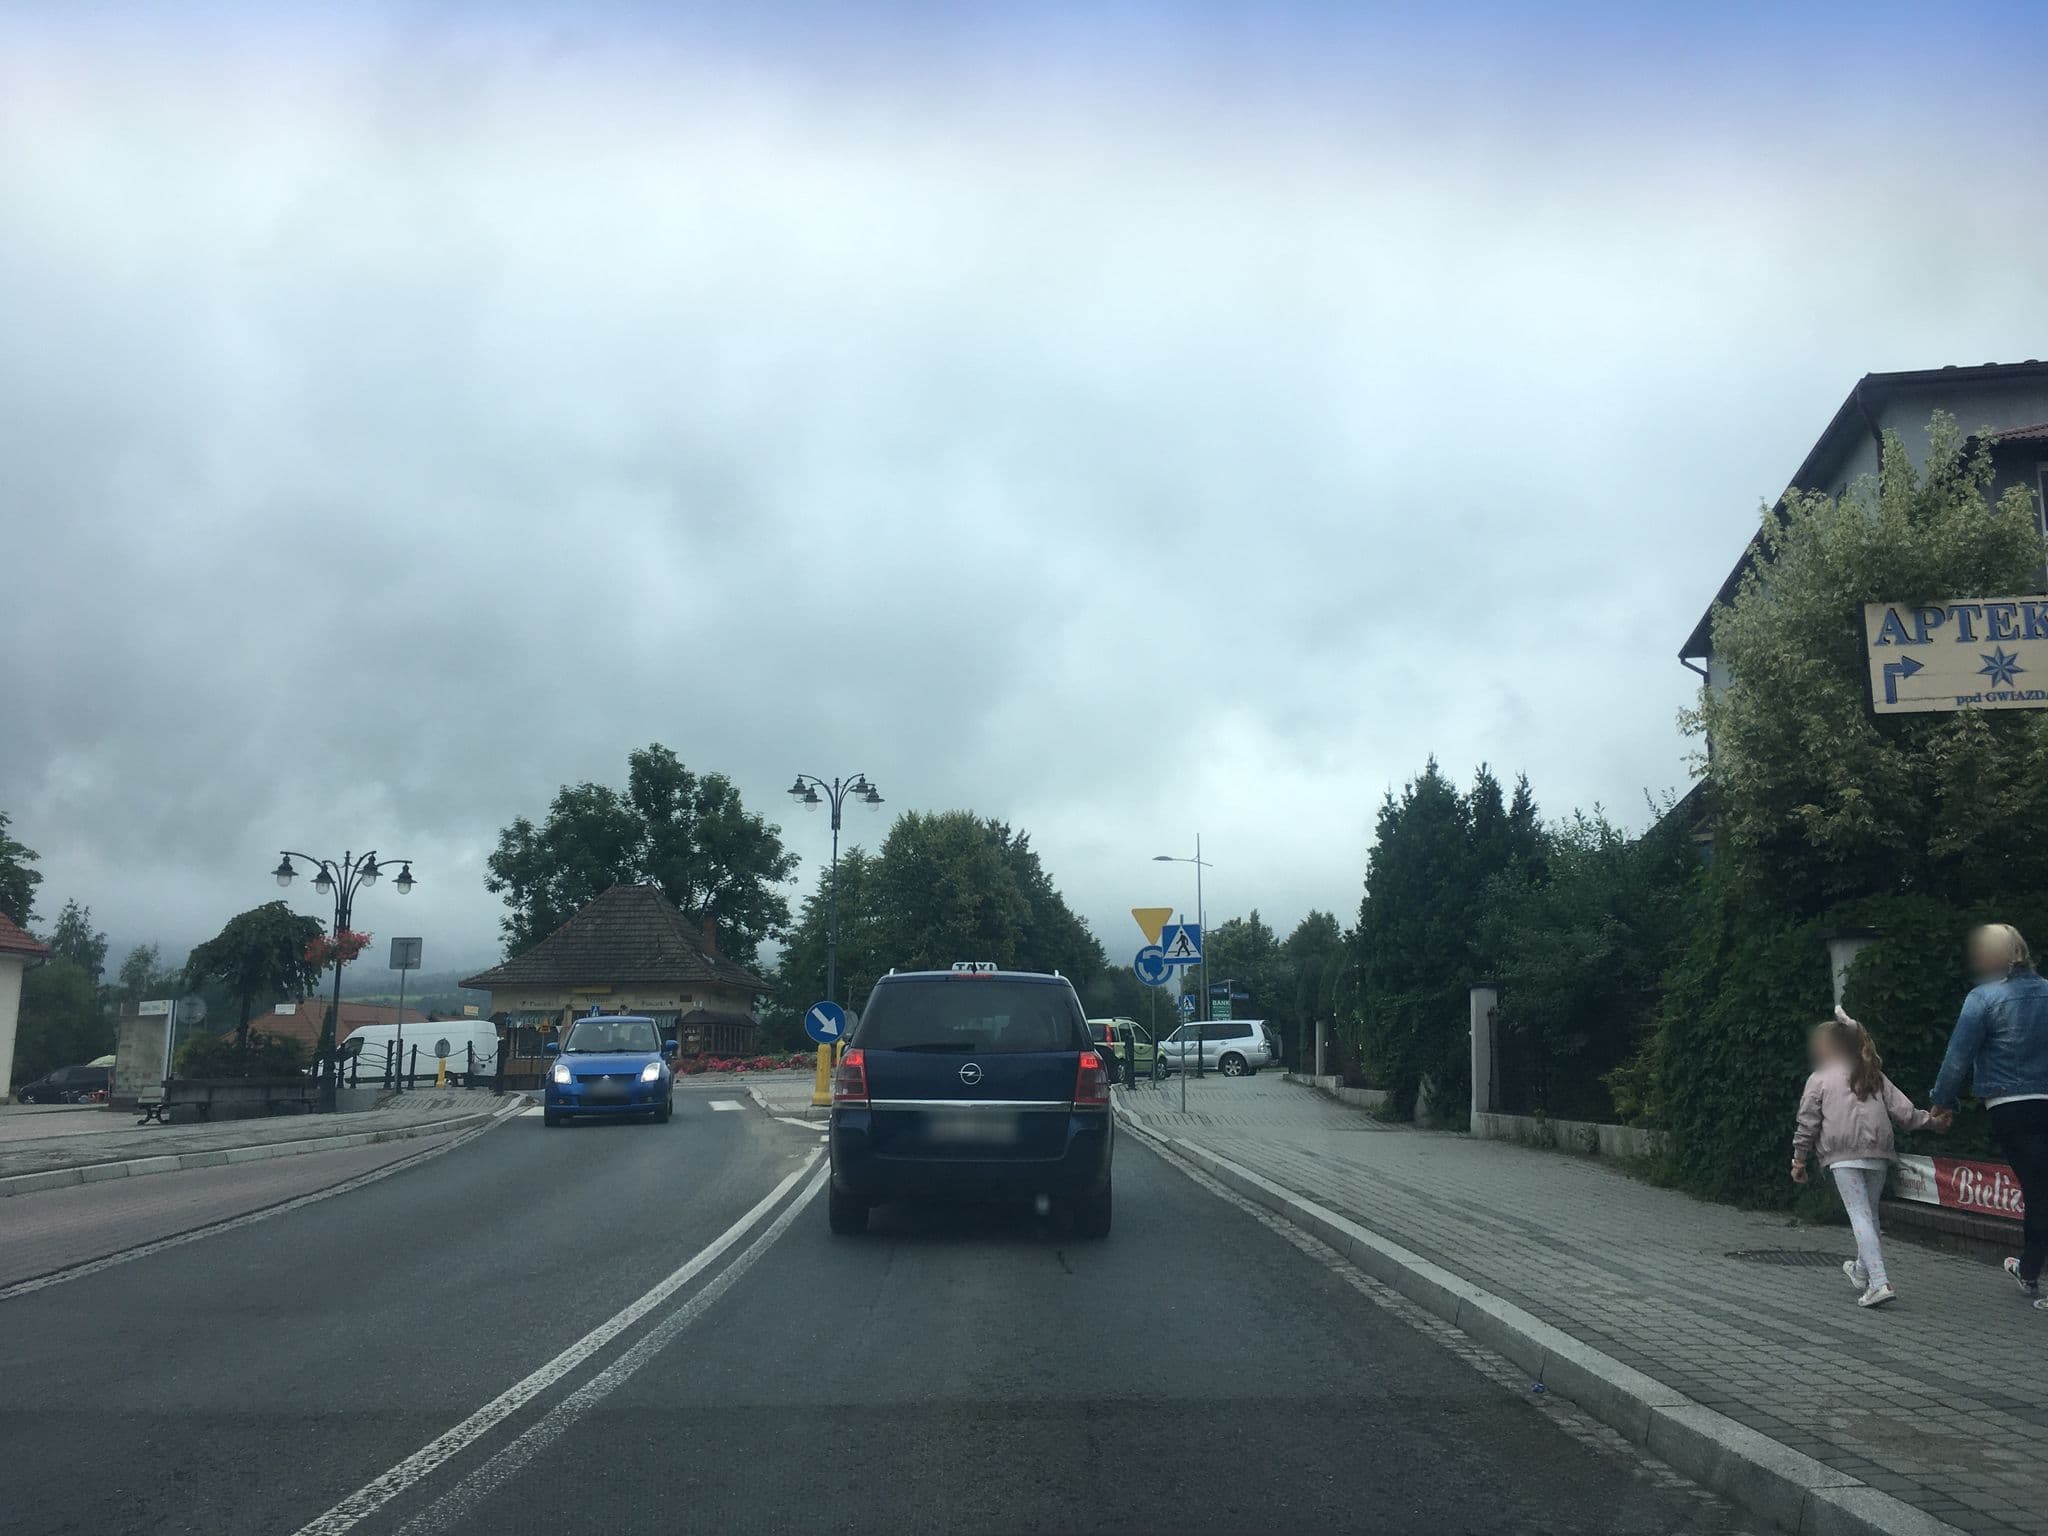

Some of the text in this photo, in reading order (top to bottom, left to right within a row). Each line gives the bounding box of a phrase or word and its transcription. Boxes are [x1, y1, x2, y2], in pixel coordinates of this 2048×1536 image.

[1956, 689, 2048, 706] pod GWIAZD
[955, 963, 994, 972] TAXI
[1952, 1166, 2026, 1213] Bieliz
